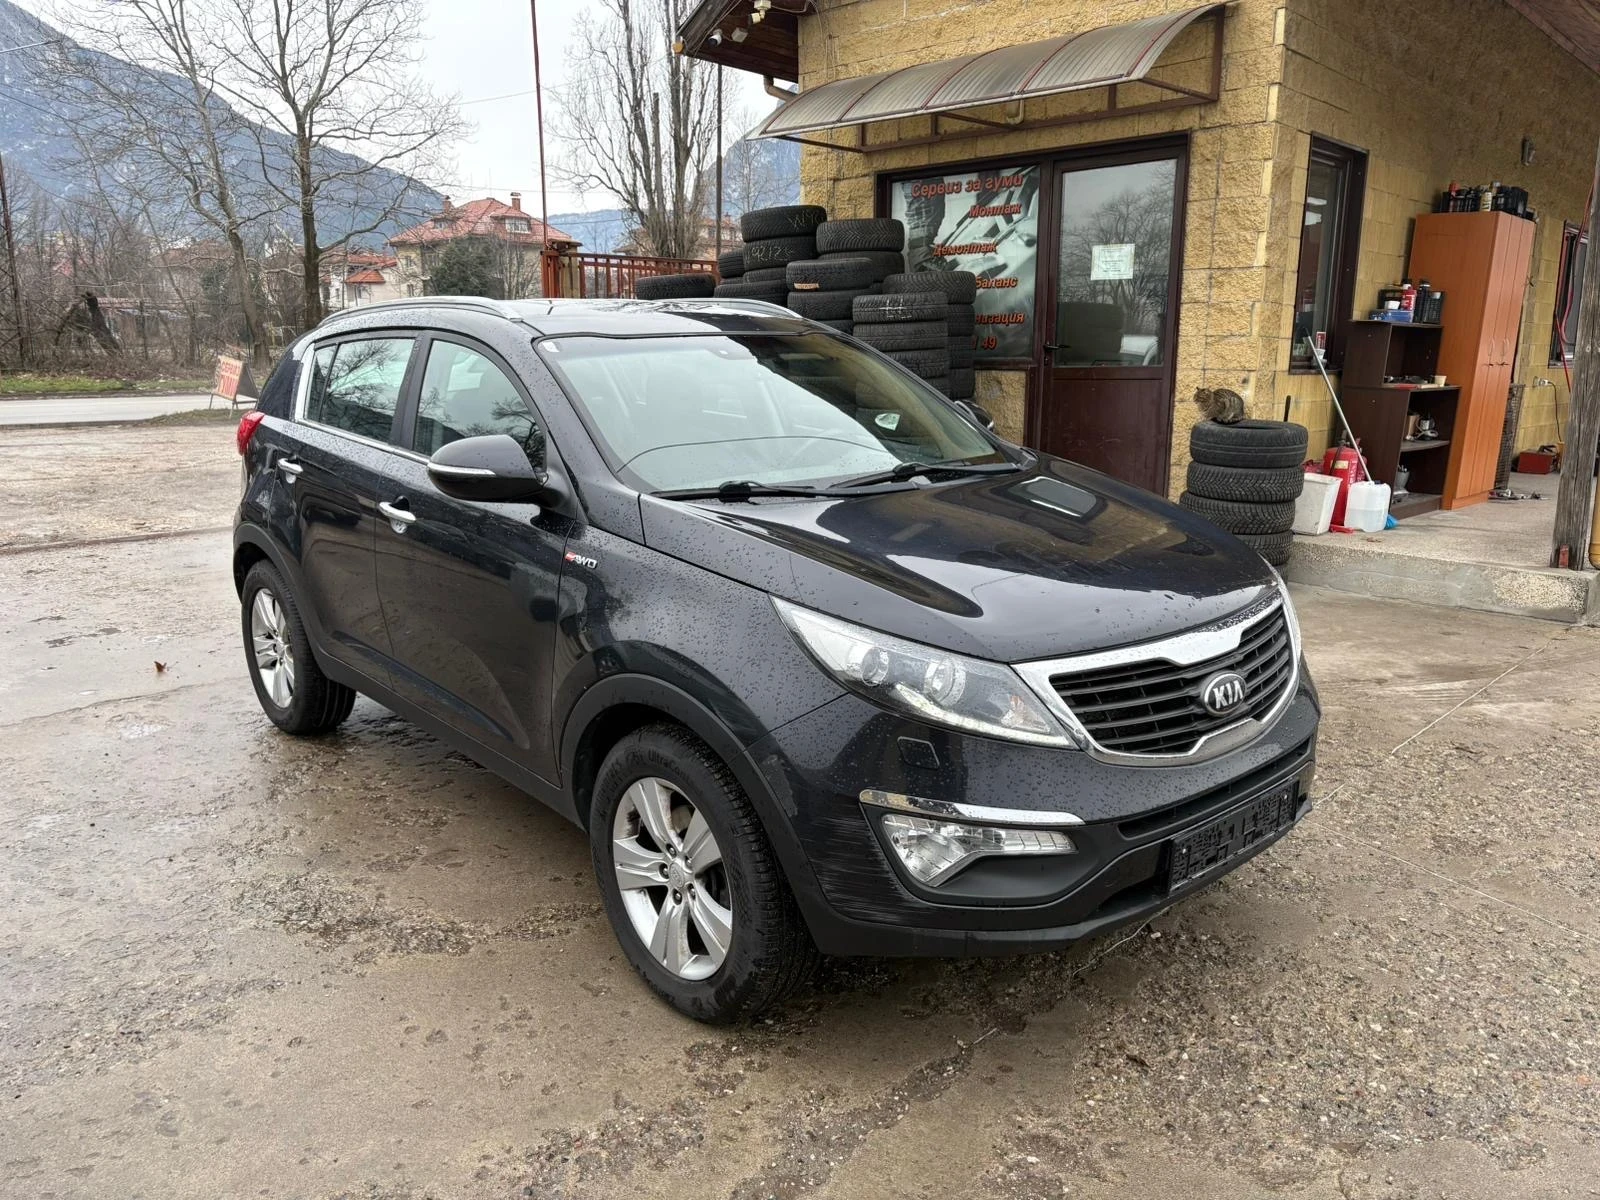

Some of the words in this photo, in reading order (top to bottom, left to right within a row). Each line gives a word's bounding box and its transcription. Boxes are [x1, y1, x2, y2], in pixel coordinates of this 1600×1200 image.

[911, 181, 962, 199] Сервиз
[965, 179, 982, 193] за
[985, 174, 1024, 192] гуми
[969, 203, 1022, 218] Монтаж
[933, 242, 997, 257] Демонтаж
[975, 312, 1025, 326] низация
[1212, 679, 1244, 709] KIA
